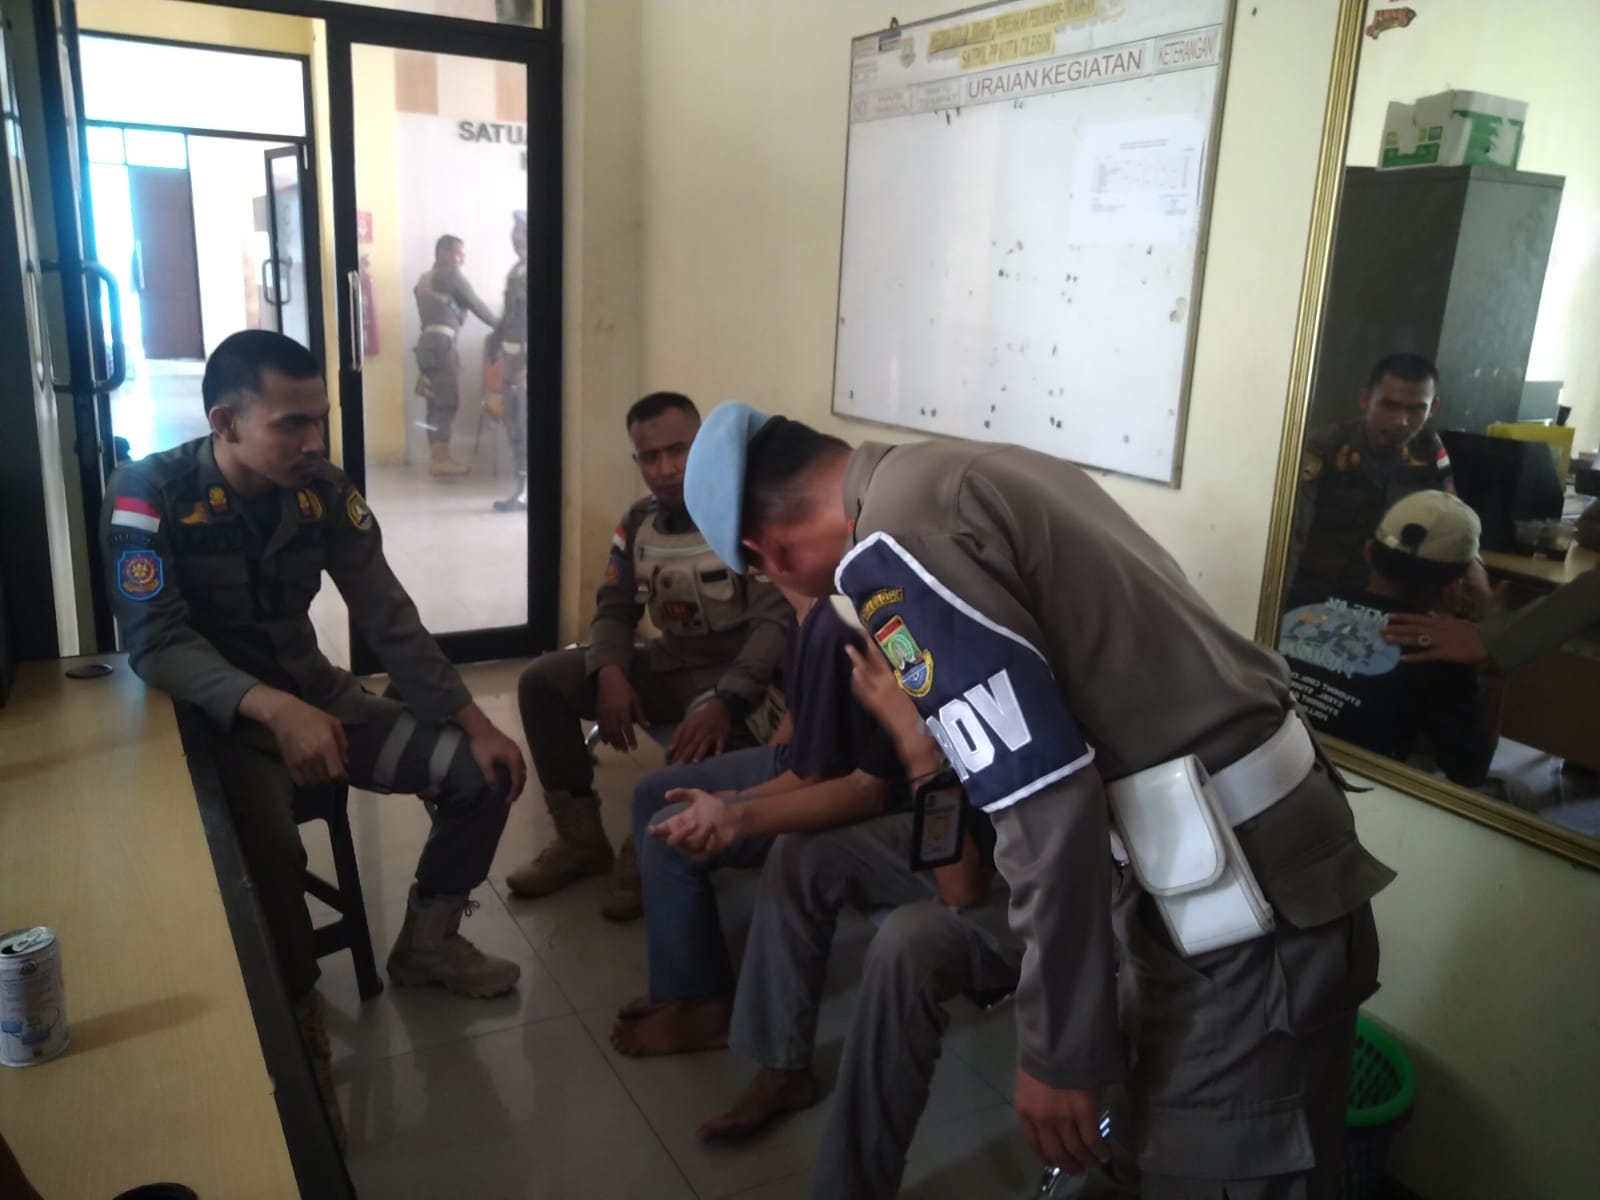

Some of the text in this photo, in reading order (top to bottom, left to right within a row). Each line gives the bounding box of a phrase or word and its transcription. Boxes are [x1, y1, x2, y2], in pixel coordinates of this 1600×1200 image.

[968, 69, 1038, 98] URAIAN
[1041, 49, 1142, 87] KEGIATAN
[457, 120, 527, 146] SATU
